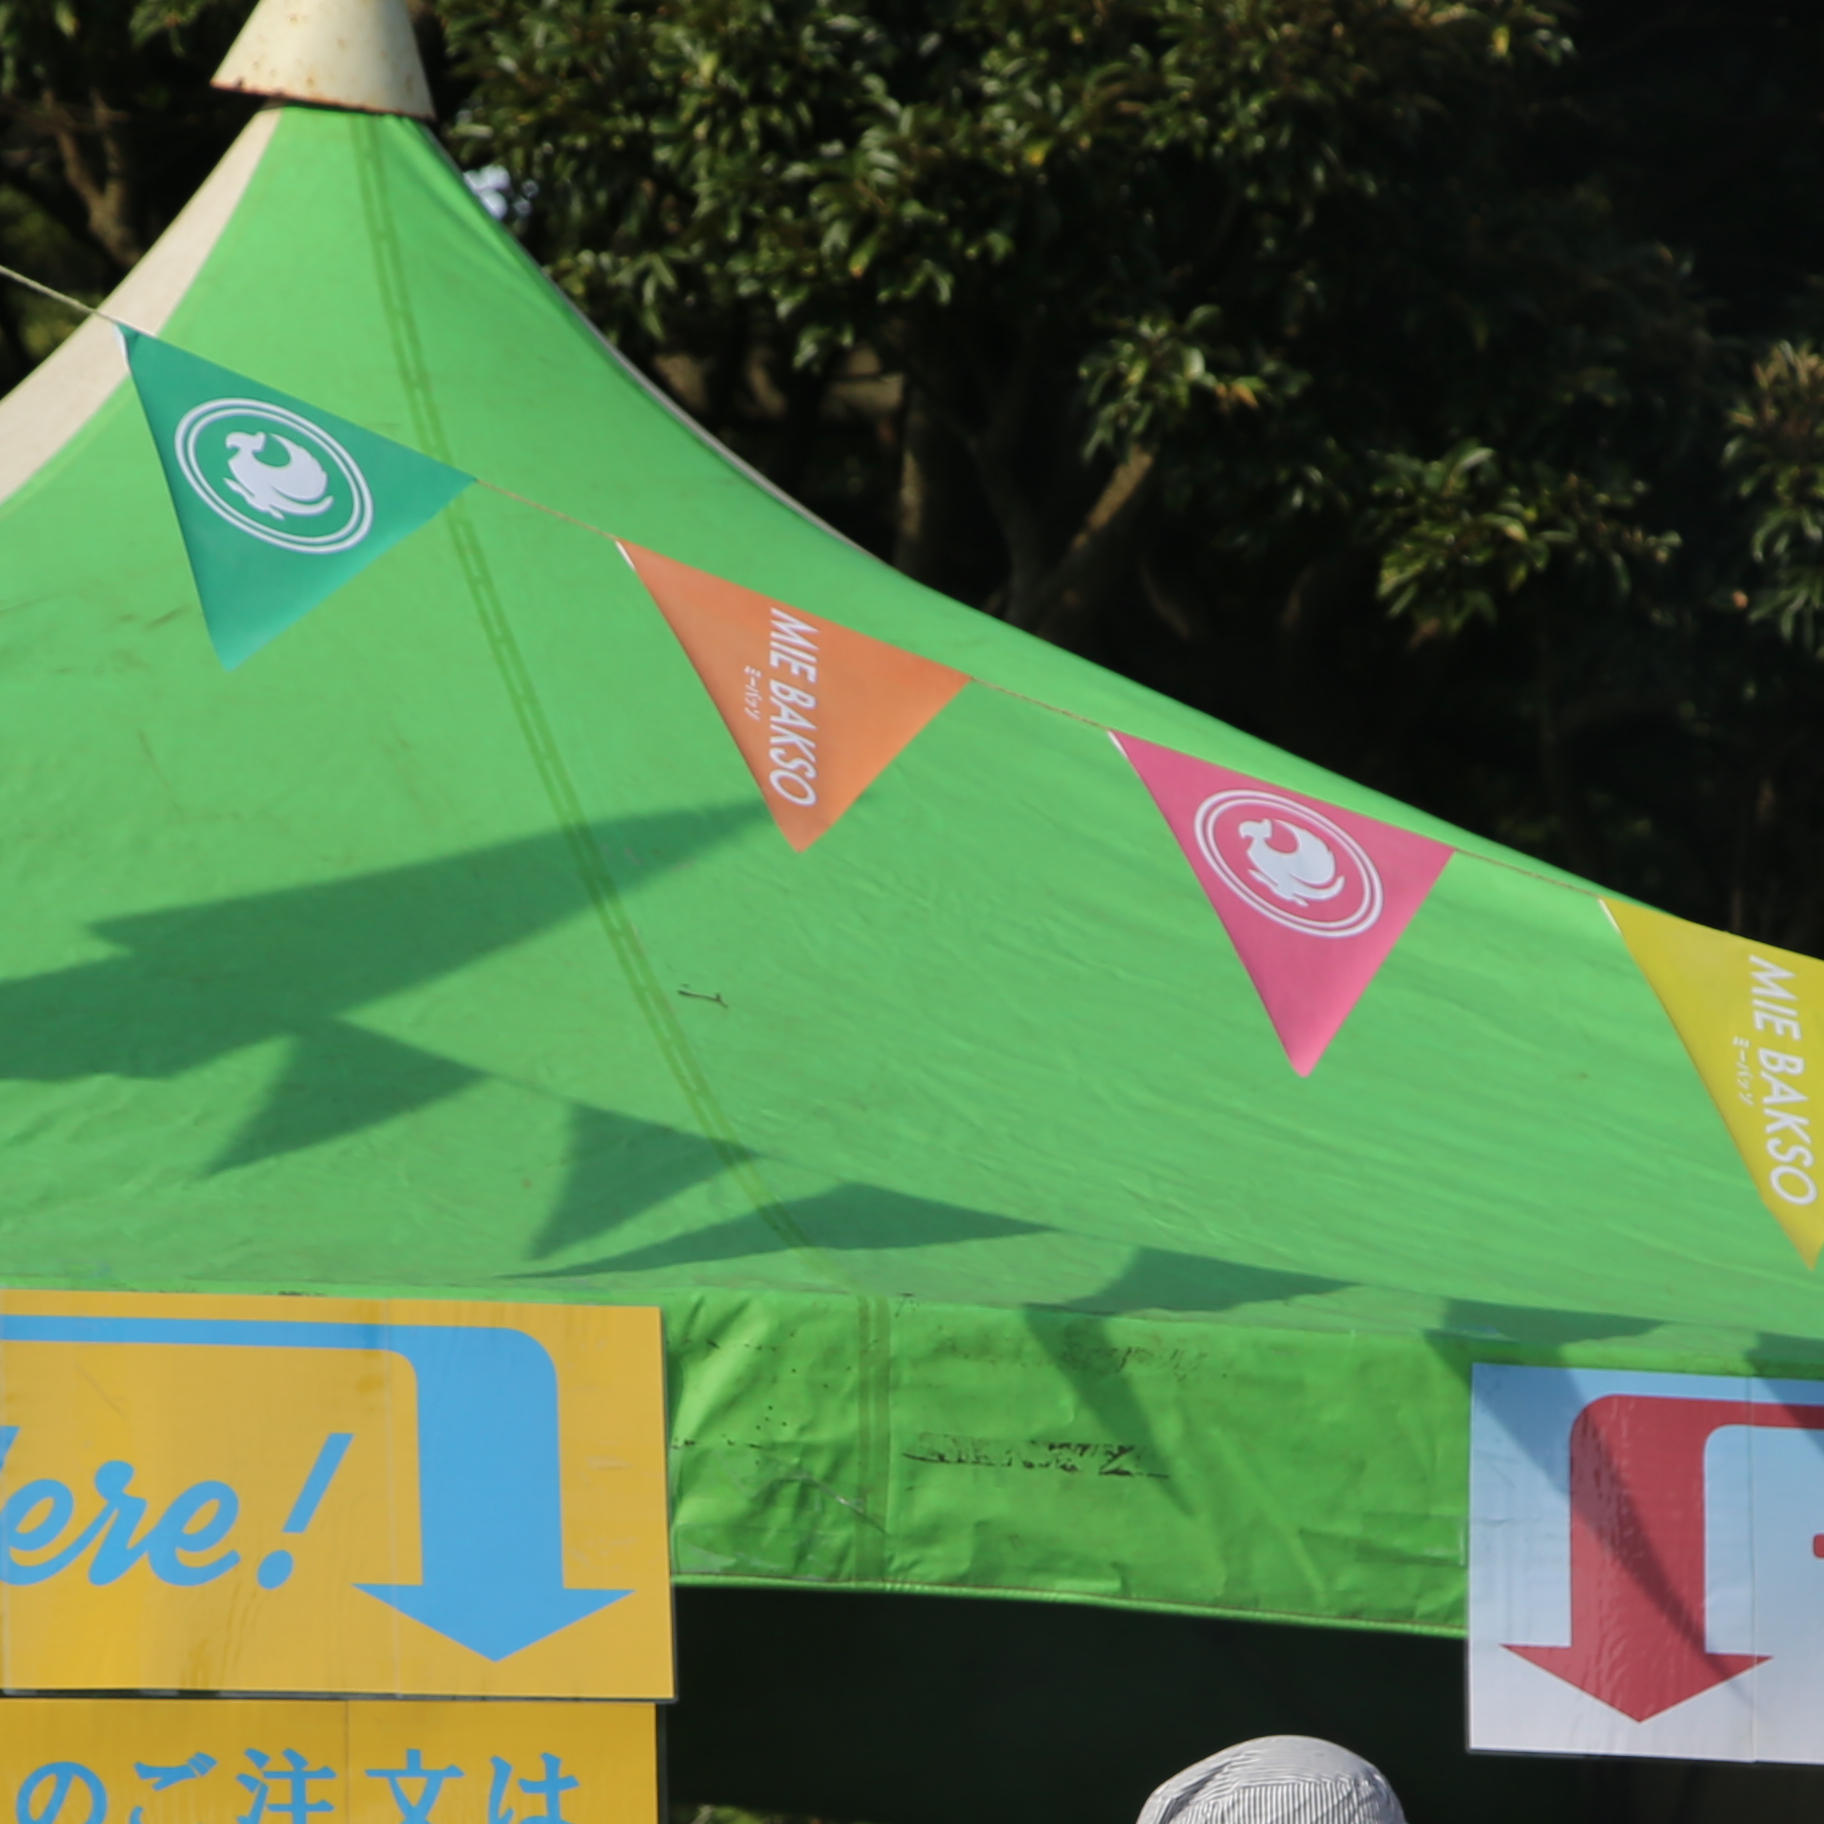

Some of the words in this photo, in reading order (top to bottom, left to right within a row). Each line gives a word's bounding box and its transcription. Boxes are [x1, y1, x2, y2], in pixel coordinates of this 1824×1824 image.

[767, 607, 820, 685] MIE
[768, 686, 818, 807] BAKSO
[1746, 955, 1804, 1043] MIE
[1756, 1048, 1819, 1206] BAKSO
